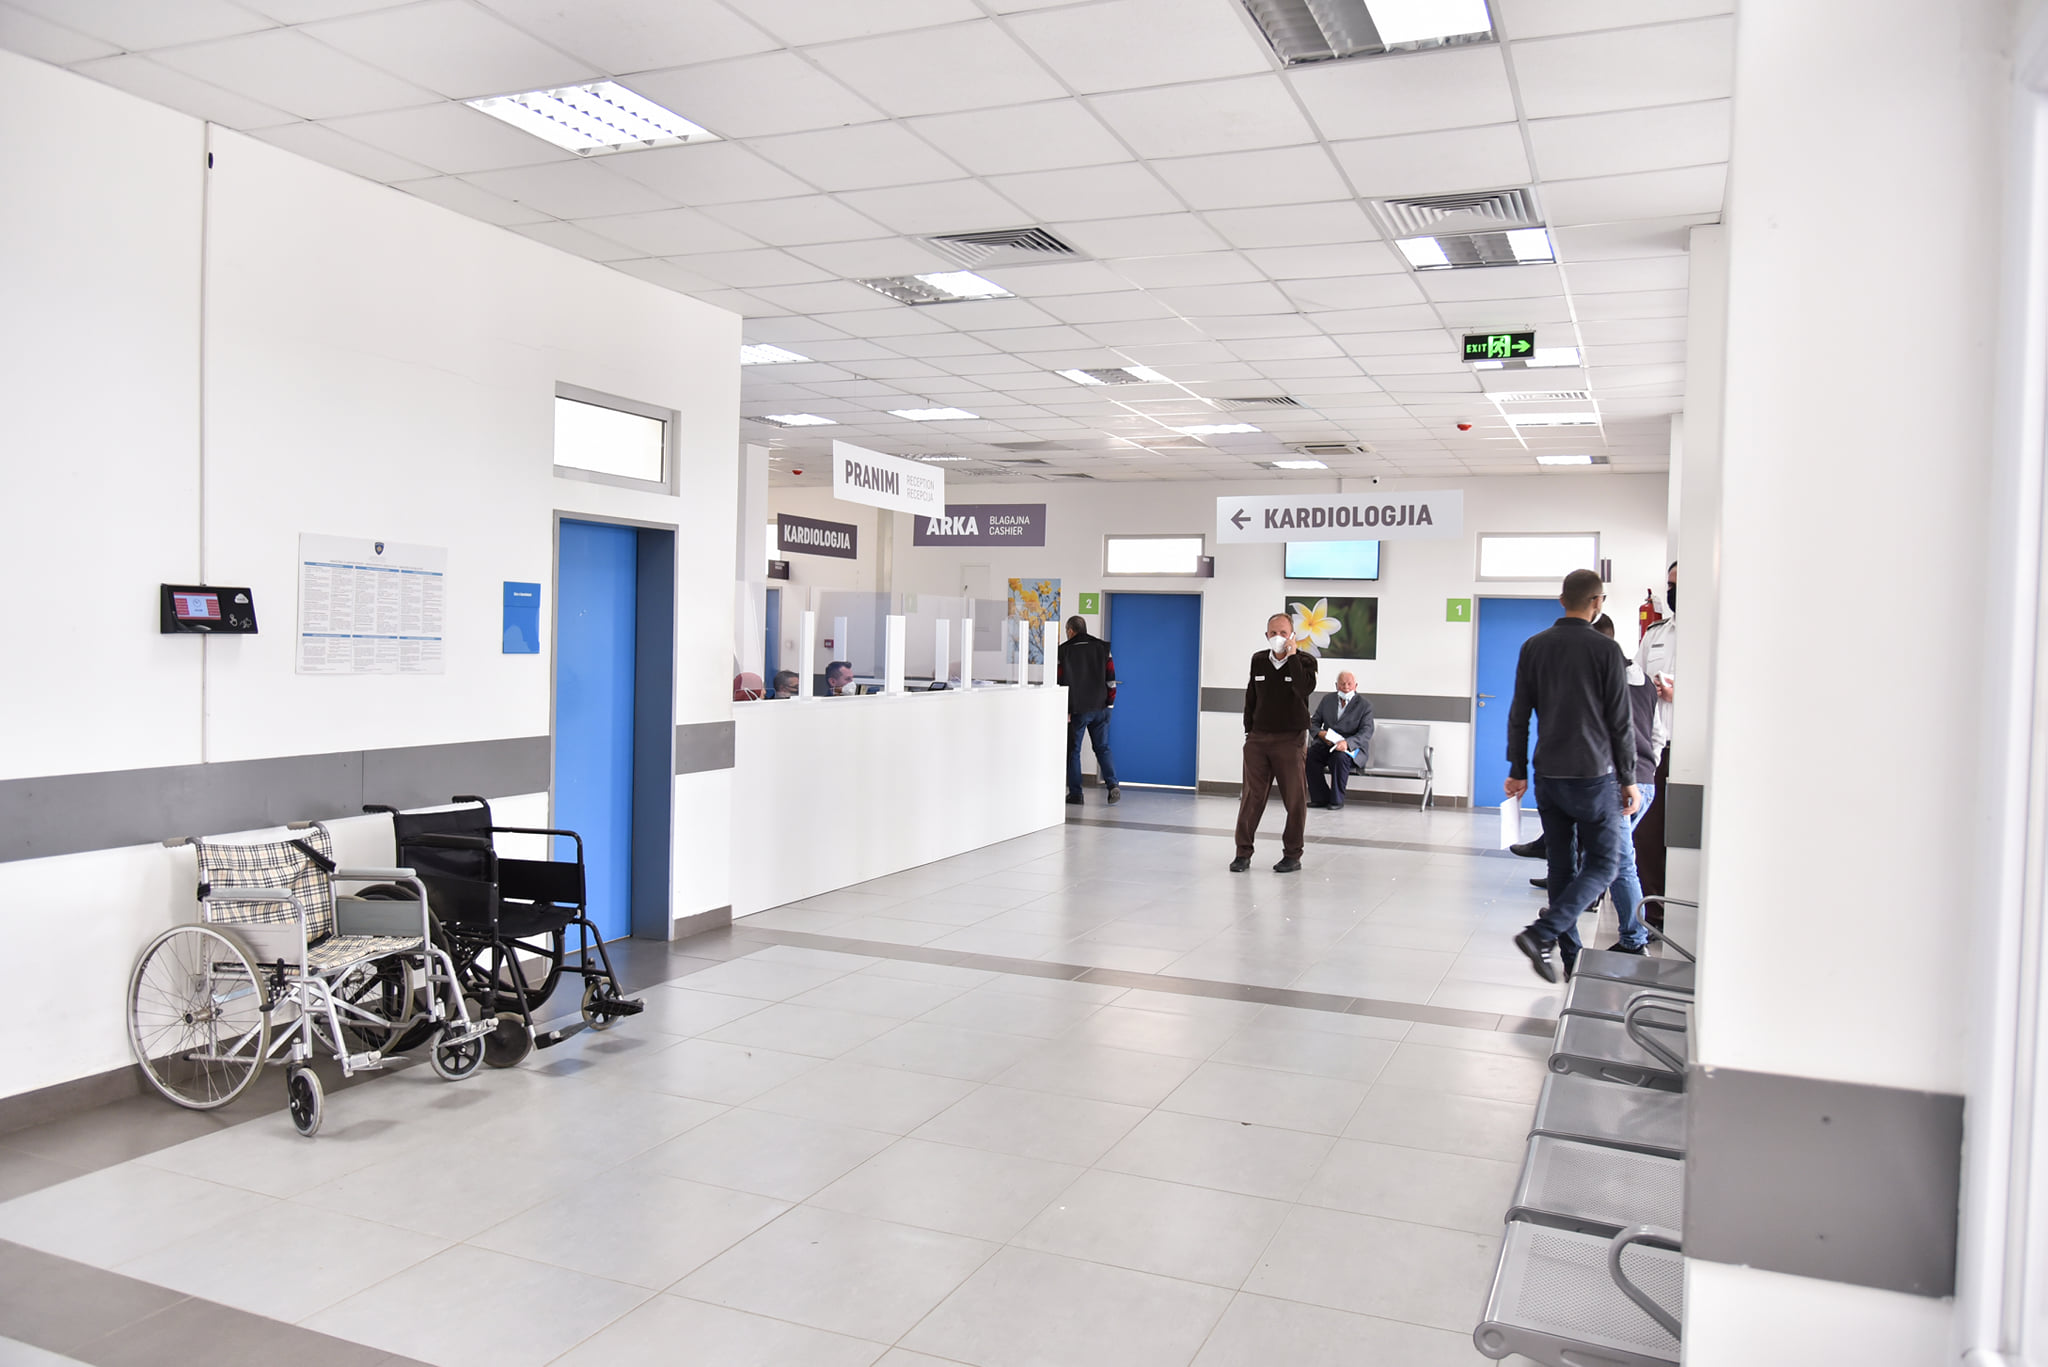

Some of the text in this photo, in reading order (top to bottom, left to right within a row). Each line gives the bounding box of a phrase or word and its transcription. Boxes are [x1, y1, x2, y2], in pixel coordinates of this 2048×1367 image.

[1466, 343, 1487, 353] EXIT
[845, 459, 900, 496] PRANIMI
[906, 474, 935, 491] RECEPTION
[989, 515, 1031, 525] BLAGAJNA
[1264, 504, 1433, 529] KARDIOLOGJIA
[926, 516, 979, 536] ARKA
[989, 526, 1023, 536] CASHIER
[784, 524, 851, 550] KARDIOLOGJIA
[1086, 598, 1093, 609] 2
[1456, 604, 1463, 616] 1
